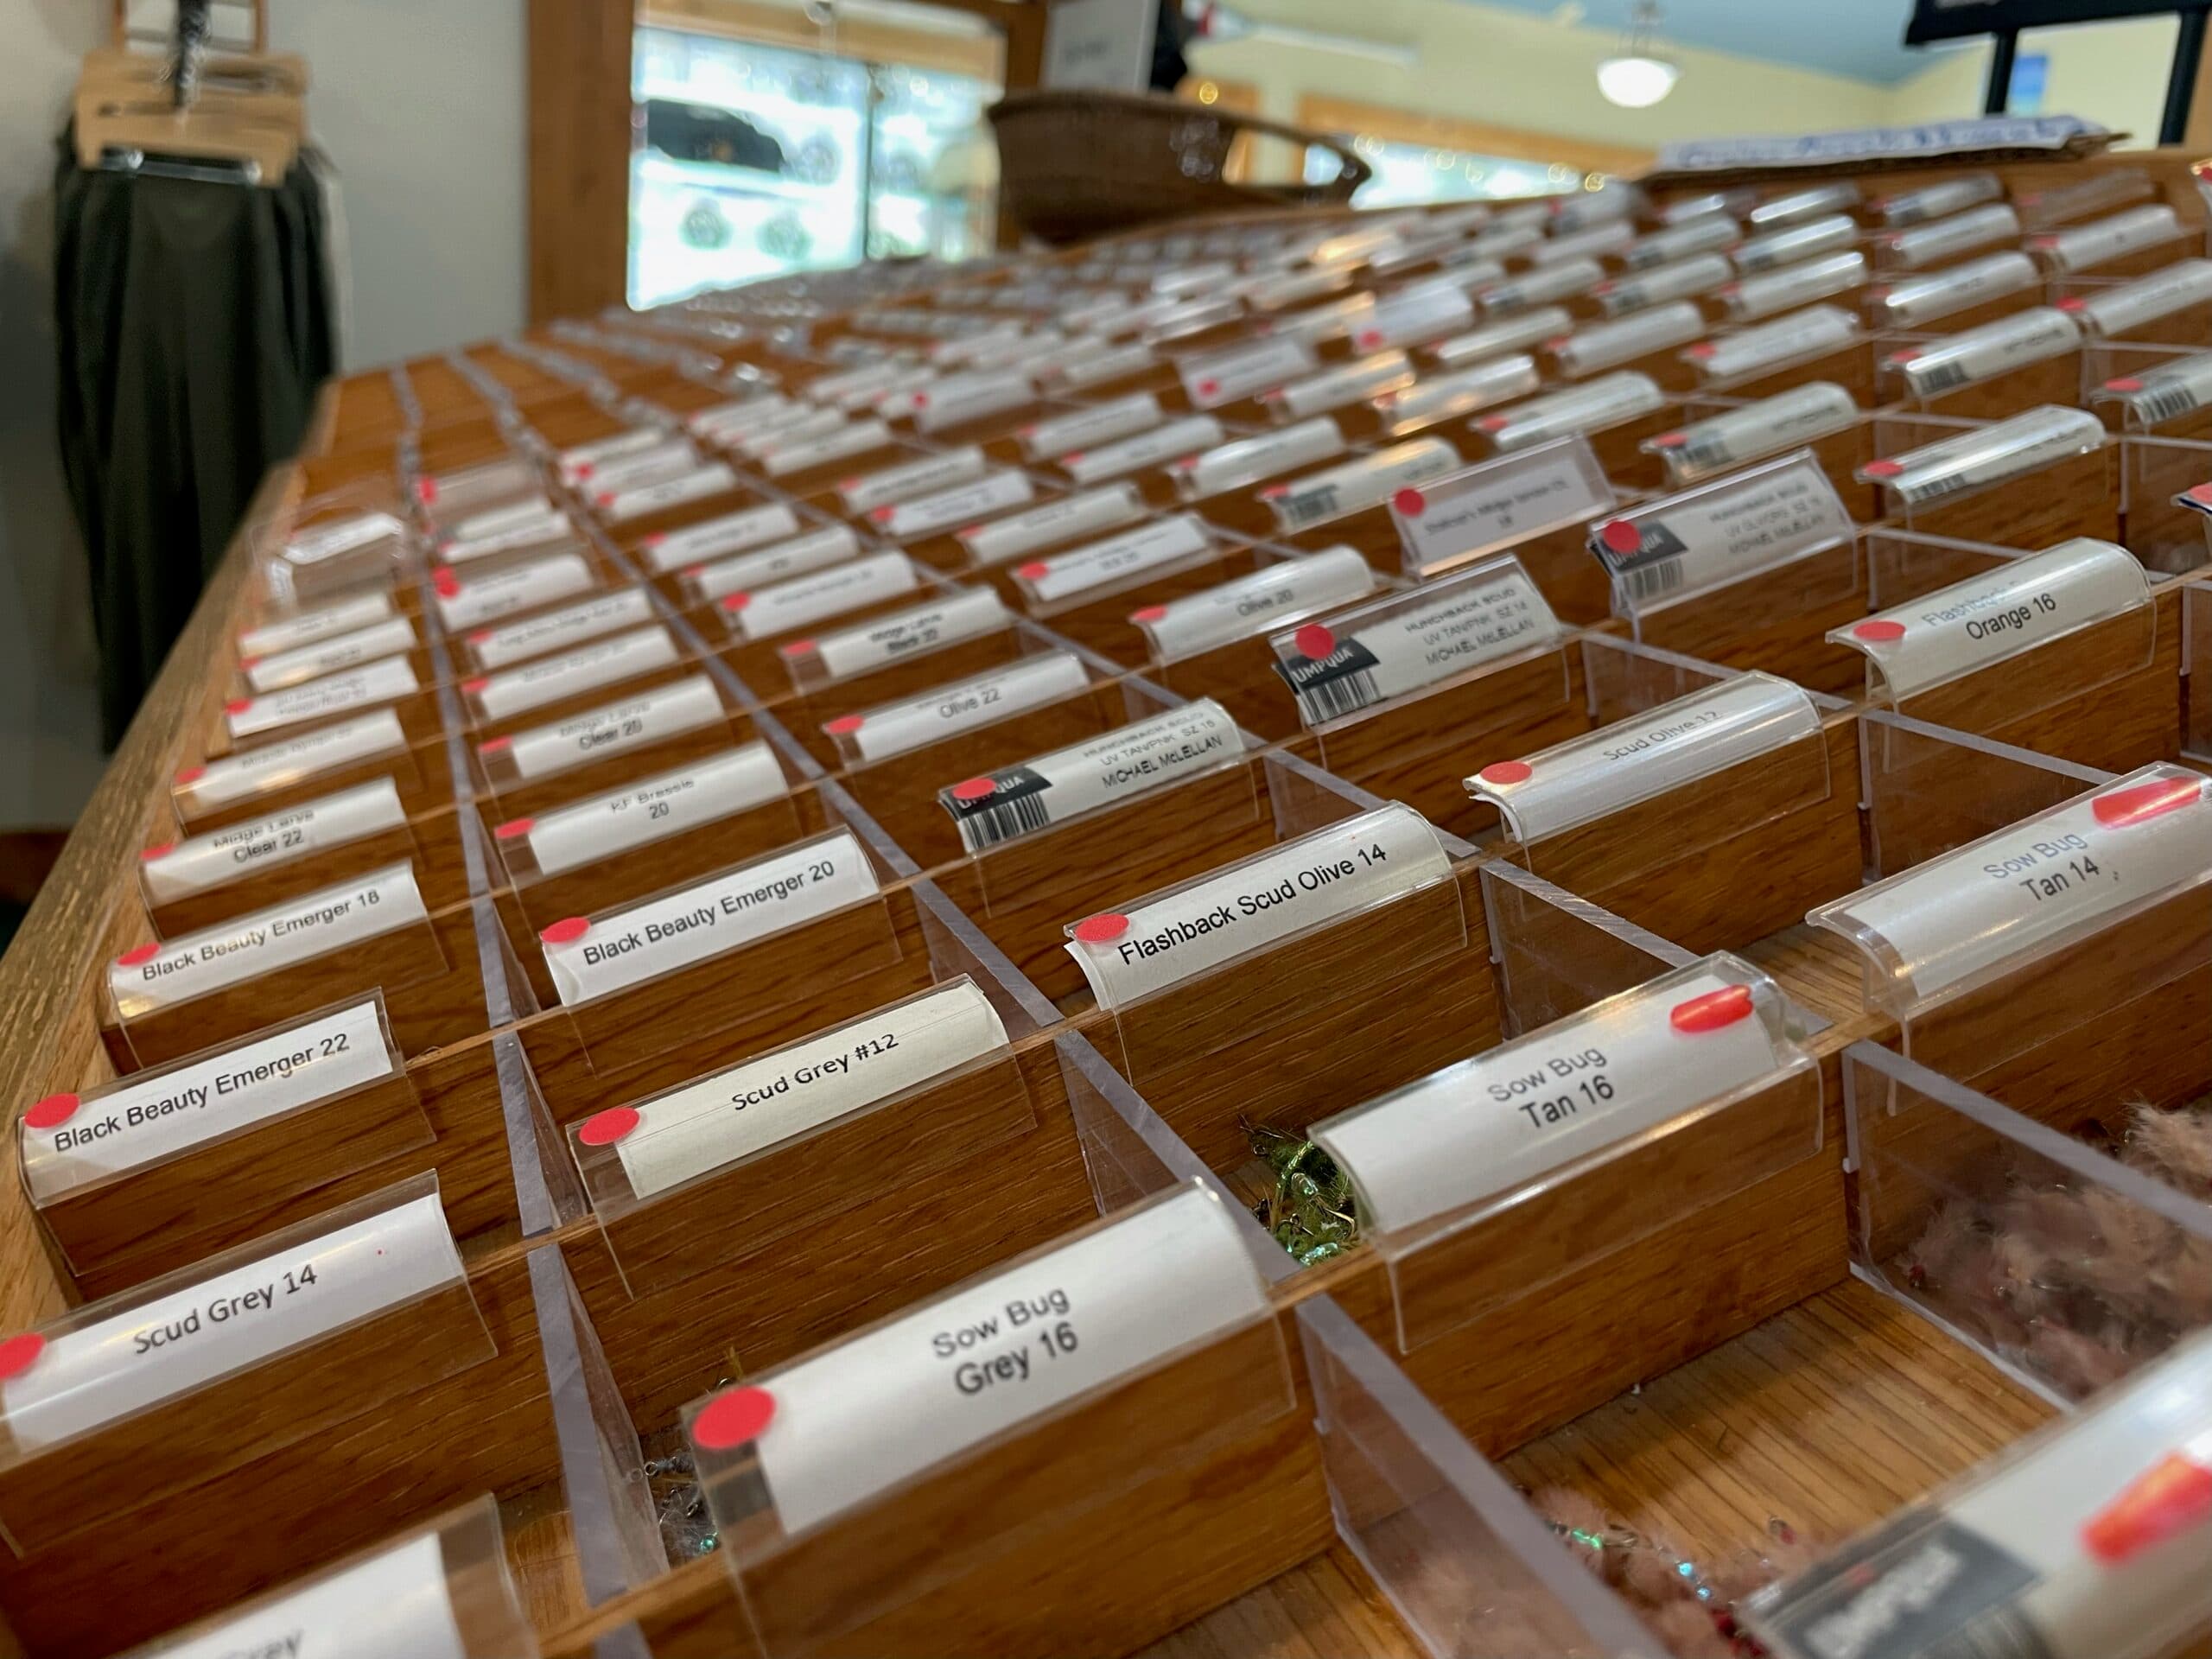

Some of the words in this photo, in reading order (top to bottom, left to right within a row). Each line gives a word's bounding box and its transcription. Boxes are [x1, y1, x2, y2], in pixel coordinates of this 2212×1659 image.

[1966, 604, 2032, 640] Orange
[2032, 593, 2056, 614] 16
[1426, 638, 1477, 665] MICHAEL
[939, 697, 979, 719] Olive
[982, 689, 1002, 704] 22
[1099, 752, 1120, 766] UV
[1180, 724, 1202, 738] SZ
[1102, 759, 1160, 789] MICHAEL
[1159, 735, 1224, 768] McLELLAN
[1603, 740, 1650, 760] Scud
[1649, 719, 1698, 744] Olive
[649, 802, 671, 820] 20
[233, 840, 277, 863] Clear
[283, 829, 305, 849] 22
[1984, 850, 2033, 880] Sow
[2033, 831, 2090, 859] Bug
[1117, 905, 1237, 966] Flashback
[1236, 879, 1297, 917] Scud
[1297, 858, 1356, 892] Olive
[1357, 842, 1388, 866] 14
[2019, 871, 2069, 902] Tan
[2070, 855, 2101, 880] 14
[142, 950, 196, 982] Black
[200, 930, 267, 963] Beauty
[272, 898, 352, 940] Emerger
[357, 888, 381, 907] 18
[582, 933, 643, 967] Black
[645, 901, 716, 944] Beauty
[721, 868, 806, 917] Emerger
[808, 859, 836, 883] 20
[54, 1115, 122, 1154] Black
[126, 1084, 208, 1128] Beauty
[215, 1042, 315, 1096] Emerger
[320, 1033, 351, 1058] 22
[731, 1077, 791, 1112] Scud
[793, 1052, 849, 1090] Grey
[854, 1033, 899, 1061] #12
[1487, 1068, 1548, 1103] Sow
[1548, 1046, 1608, 1077] Bug
[1519, 1092, 1578, 1129] Tan
[1580, 1074, 1616, 1103] 16
[133, 1315, 202, 1355] Scud
[208, 1282, 276, 1324] Grey
[283, 1264, 319, 1294] 14
[931, 1316, 1001, 1360] Sow
[1004, 1287, 1072, 1328] Bug
[954, 1343, 1033, 1397] Grey
[1039, 1322, 1080, 1359] 16
